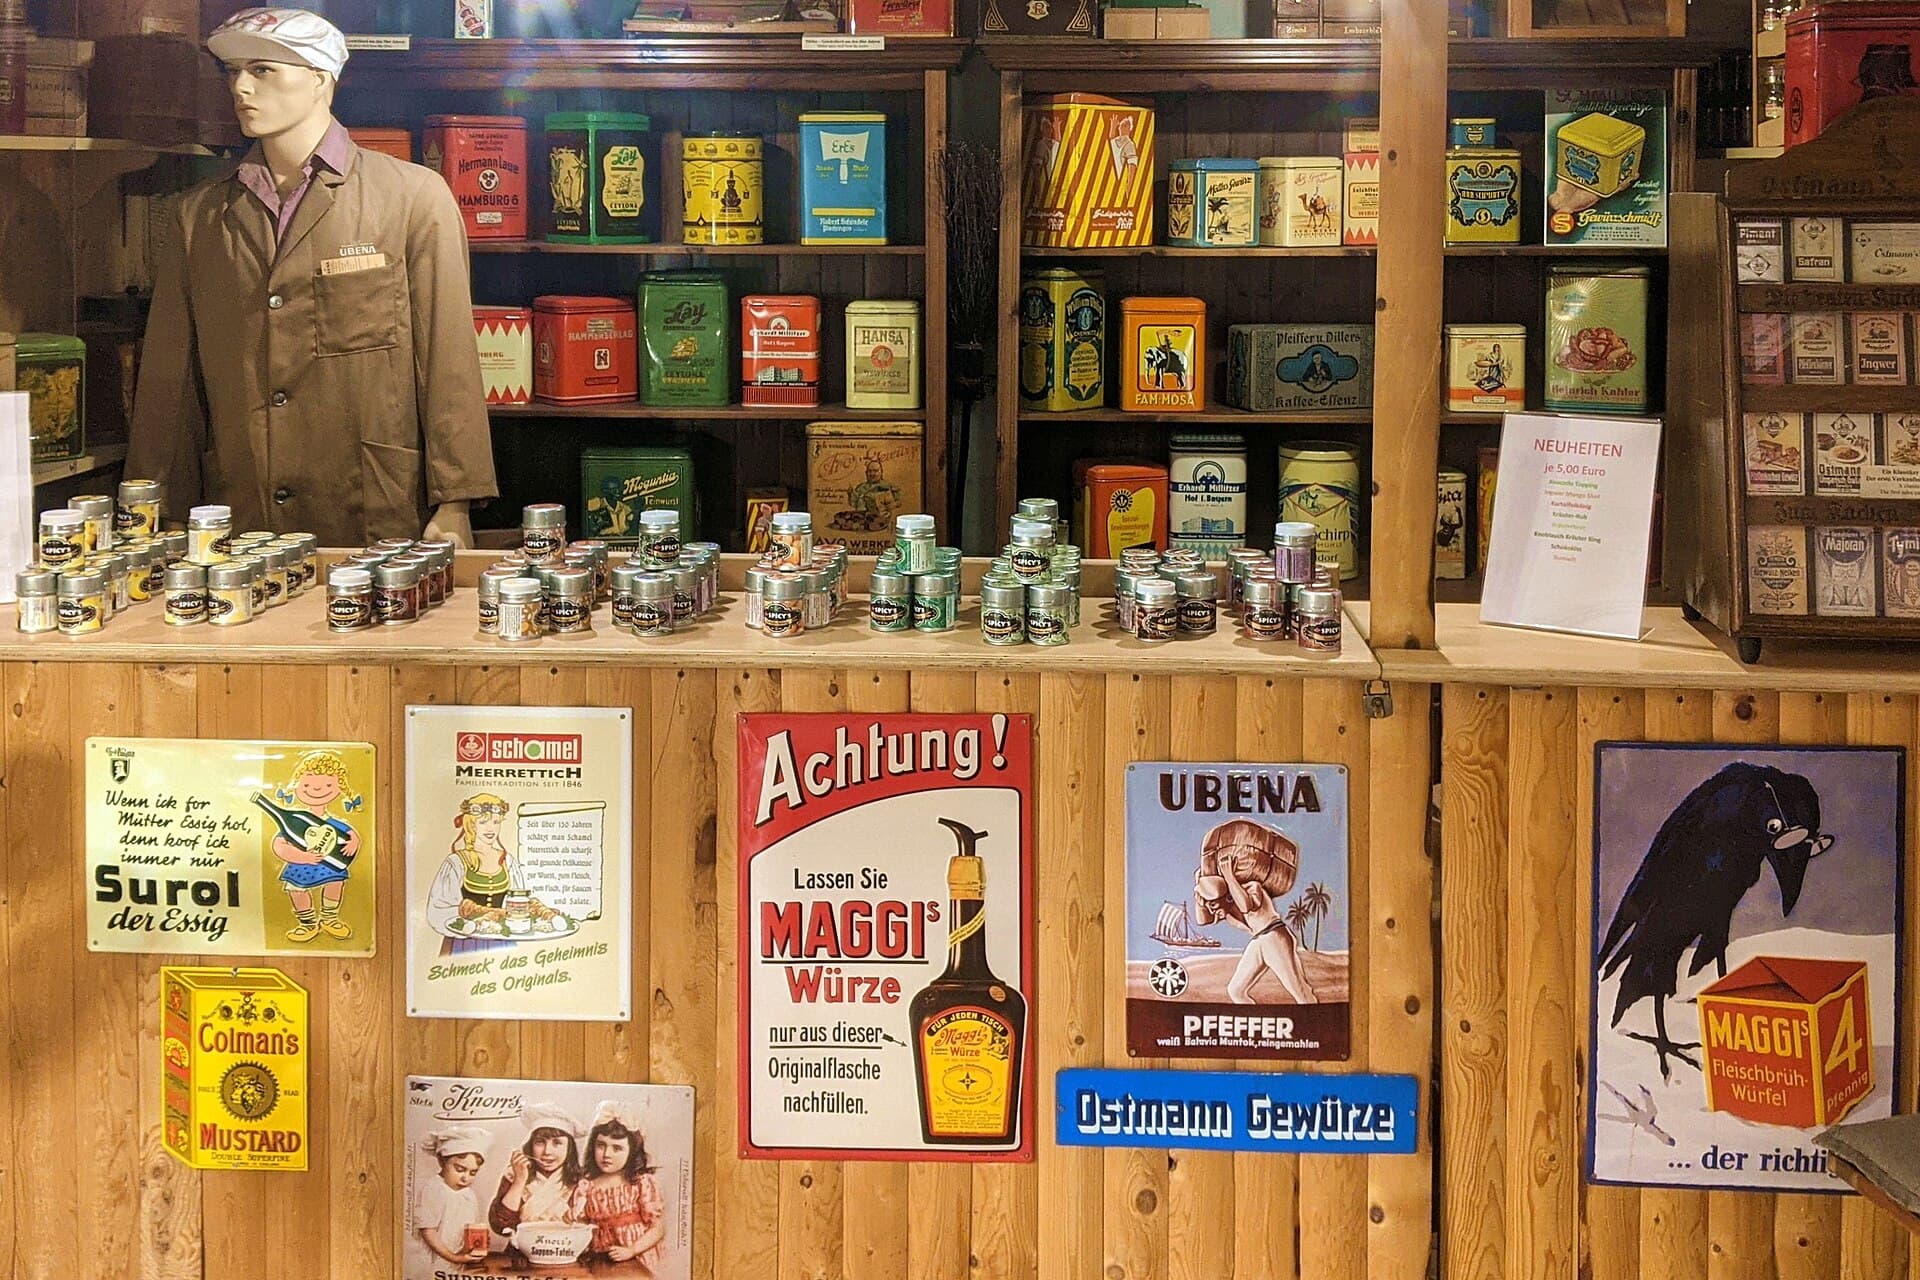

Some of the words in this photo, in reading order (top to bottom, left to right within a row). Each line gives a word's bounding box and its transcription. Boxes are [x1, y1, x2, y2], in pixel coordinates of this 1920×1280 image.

[611, 148, 638, 166] Lay
[832, 140, 855, 153] ErEs
[459, 157, 498, 175] Hermann
[459, 194, 510, 206] HAMBURG
[511, 194, 519, 206] 6
[1740, 229, 1776, 239] Piment
[339, 246, 376, 257] UBENA
[1798, 257, 1830, 268] Safran
[663, 301, 708, 325] Lay
[862, 330, 905, 345] HANSA
[1552, 385, 1597, 398] Heinrich
[1534, 438, 1623, 457] NEUHEITEN
[1544, 463, 1554, 474] je
[1557, 463, 1580, 474] 5,00
[1582, 466, 1606, 476] Euro
[622, 470, 679, 495] Moguntia
[1178, 484, 1206, 492] Erhardt
[1207, 495, 1232, 503] Bayern
[1825, 536, 1865, 553] Majoran
[1017, 558, 1041, 566] SPICY'S
[1187, 609, 1210, 617] SPICY'S
[491, 735, 578, 761] schamel
[456, 765, 582, 779] MEERRETTICH
[456, 780, 539, 788] FAMILIENTRADITION
[1159, 772, 1321, 814] UBENA
[105, 790, 149, 809] Wenn
[155, 795, 177, 809] ick
[186, 796, 211, 812] for
[181, 815, 217, 832] Essig
[222, 814, 252, 834] hol,
[120, 832, 159, 847] denn
[164, 832, 200, 852] koof
[206, 835, 230, 850] ick
[314, 827, 333, 852] Surol
[121, 850, 178, 866] immer
[95, 864, 241, 908] Surol
[794, 868, 854, 889] Lassen
[861, 868, 888, 889] Sie
[107, 906, 155, 932] der
[160, 908, 230, 942] Essig
[428, 958, 494, 981] Schmeck'
[500, 955, 528, 971] das
[534, 941, 608, 965] Geheimnis
[470, 980, 497, 996] des
[503, 969, 572, 992] Originals.
[784, 966, 902, 1003] Würze
[769, 1025, 797, 1043] nur
[800, 1026, 828, 1043] aus
[832, 1021, 883, 1043] dieser
[951, 1011, 978, 1021] JEDEN
[981, 1015, 1005, 1033] TISCH
[1184, 1015, 1294, 1039] PFEFFER
[200, 1022, 300, 1055] Colman's
[1156, 1036, 1180, 1046] weiß
[1824, 996, 1862, 1076] 4
[950, 1046, 980, 1057] Würze
[768, 1058, 881, 1084] Originalflasche
[1712, 1058, 1809, 1088] Fleischbrüh-
[1731, 1083, 1788, 1108] Würfel
[1826, 1071, 1869, 1112] Pfennig
[784, 1091, 868, 1114] nachfüllen.
[1076, 1087, 1233, 1139] Ostmann
[1246, 1093, 1396, 1142] Gewürze
[200, 1122, 302, 1153] MUSTARD
[1701, 1145, 1749, 1171] der
[1760, 1149, 1838, 1178] richti
